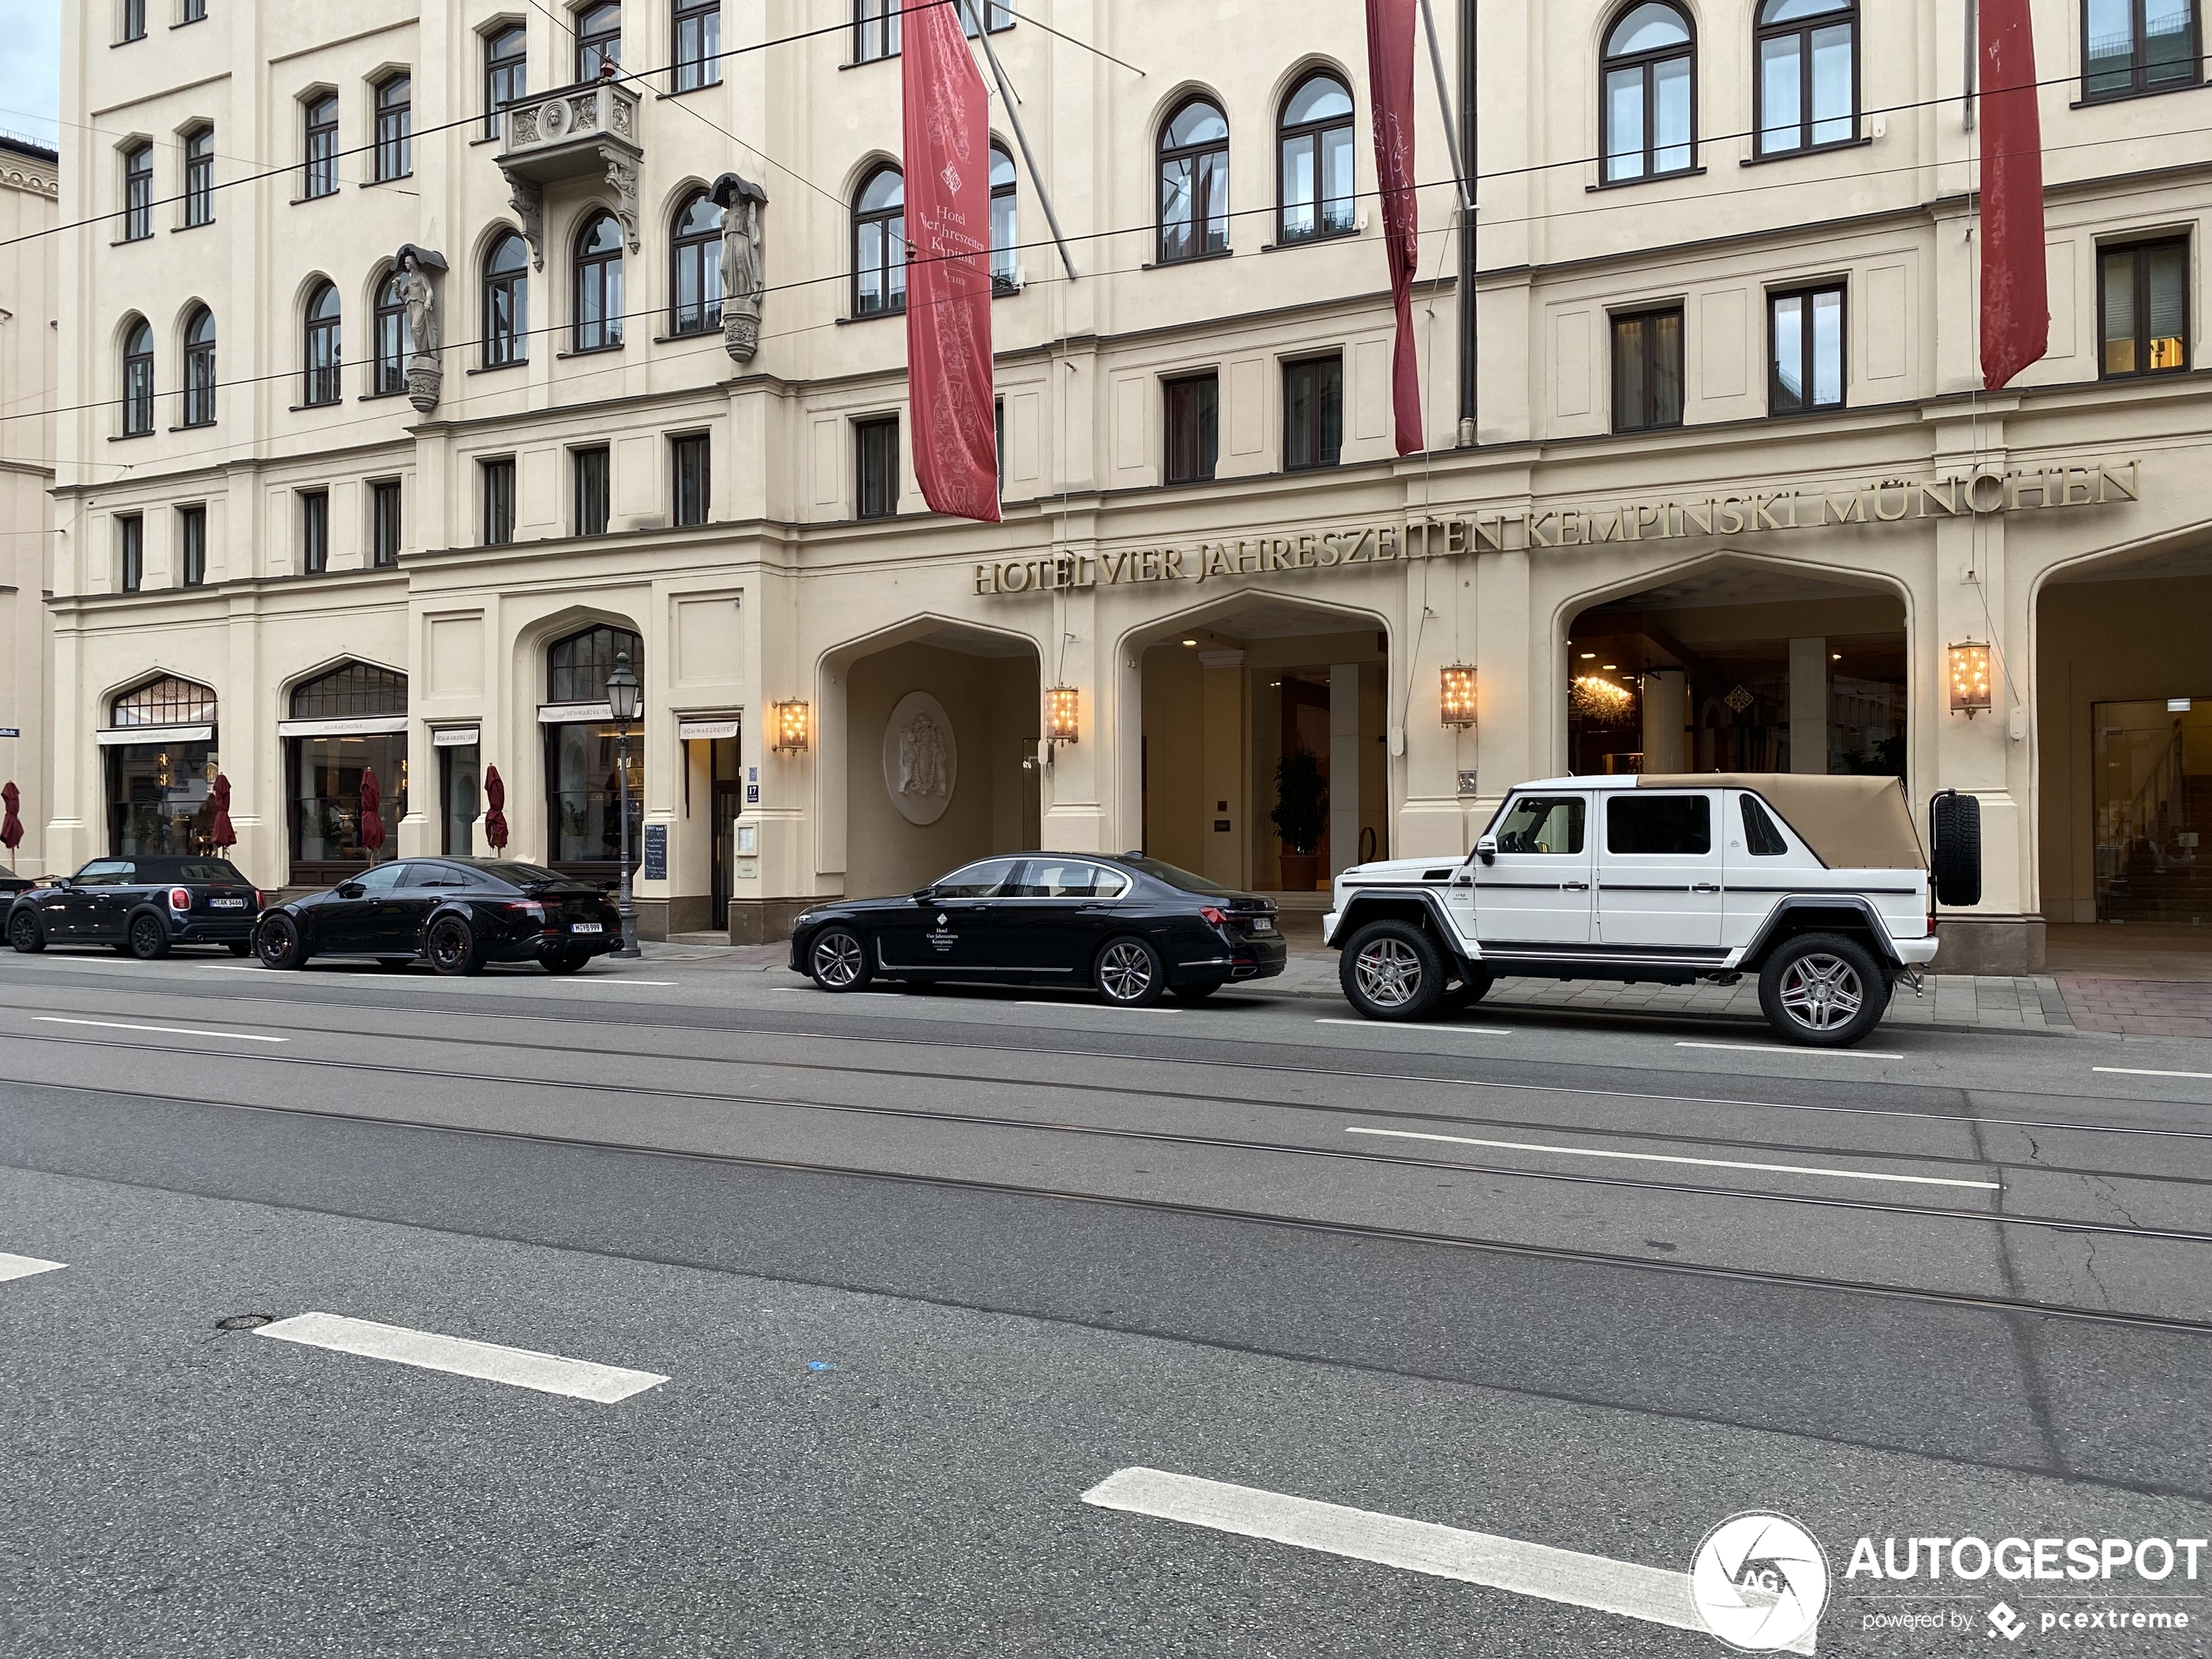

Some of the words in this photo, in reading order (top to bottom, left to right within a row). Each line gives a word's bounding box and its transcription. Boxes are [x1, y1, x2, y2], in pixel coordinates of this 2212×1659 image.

[936, 205, 966, 226] Hotel
[920, 212, 940, 231] Vier
[941, 224, 985, 252] hreszeiten
[931, 236, 976, 266] Kpinski
[971, 555, 1097, 596] HOTEL
[1102, 548, 1188, 584] VIER
[1195, 515, 1507, 584] JAHRESZEITEN
[1521, 490, 1800, 549] KEMPINSKI
[1817, 460, 2142, 525] MÜNCHEN
[748, 786, 757, 795] 17
